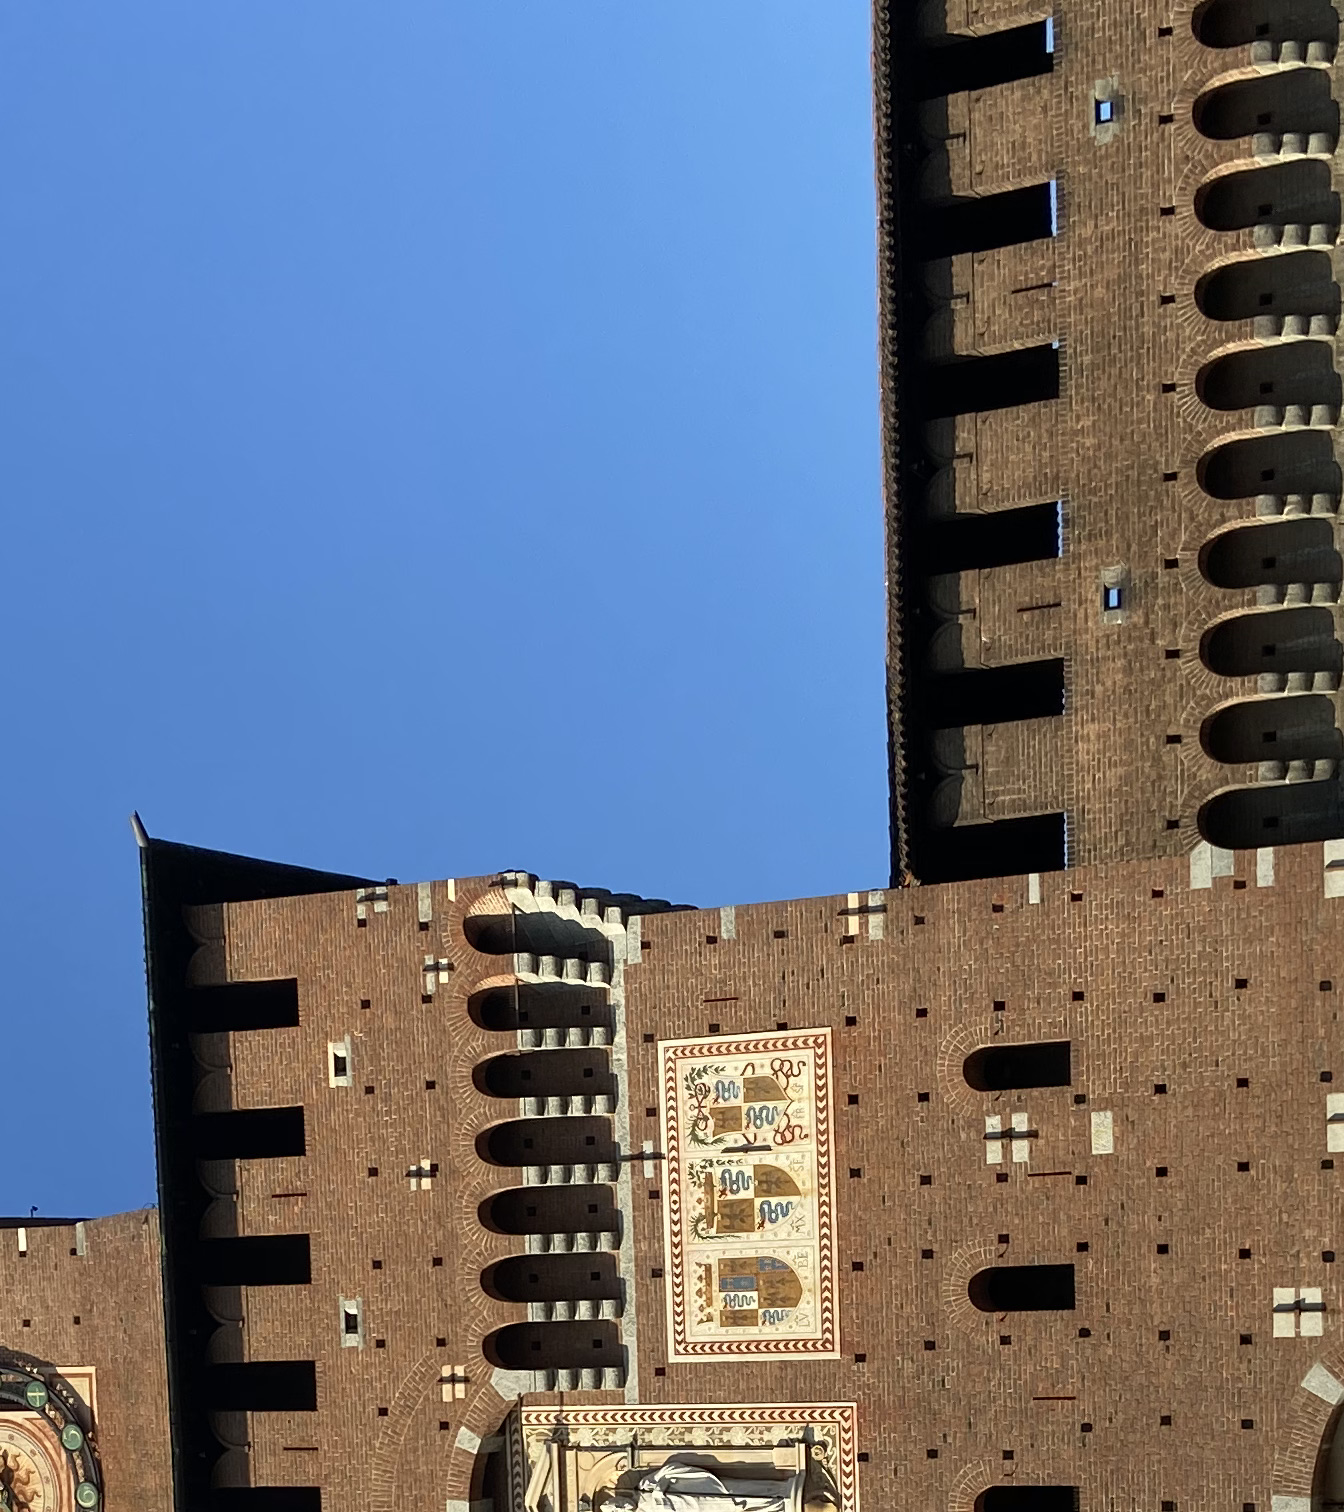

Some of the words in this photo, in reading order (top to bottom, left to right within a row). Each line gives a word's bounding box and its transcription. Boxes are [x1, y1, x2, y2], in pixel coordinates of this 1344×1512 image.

[797, 1252, 808, 1268] BE
[27, 1388, 45, 1407] 4
[63, 1430, 81, 1443] 5
[77, 1490, 96, 1507] 6
